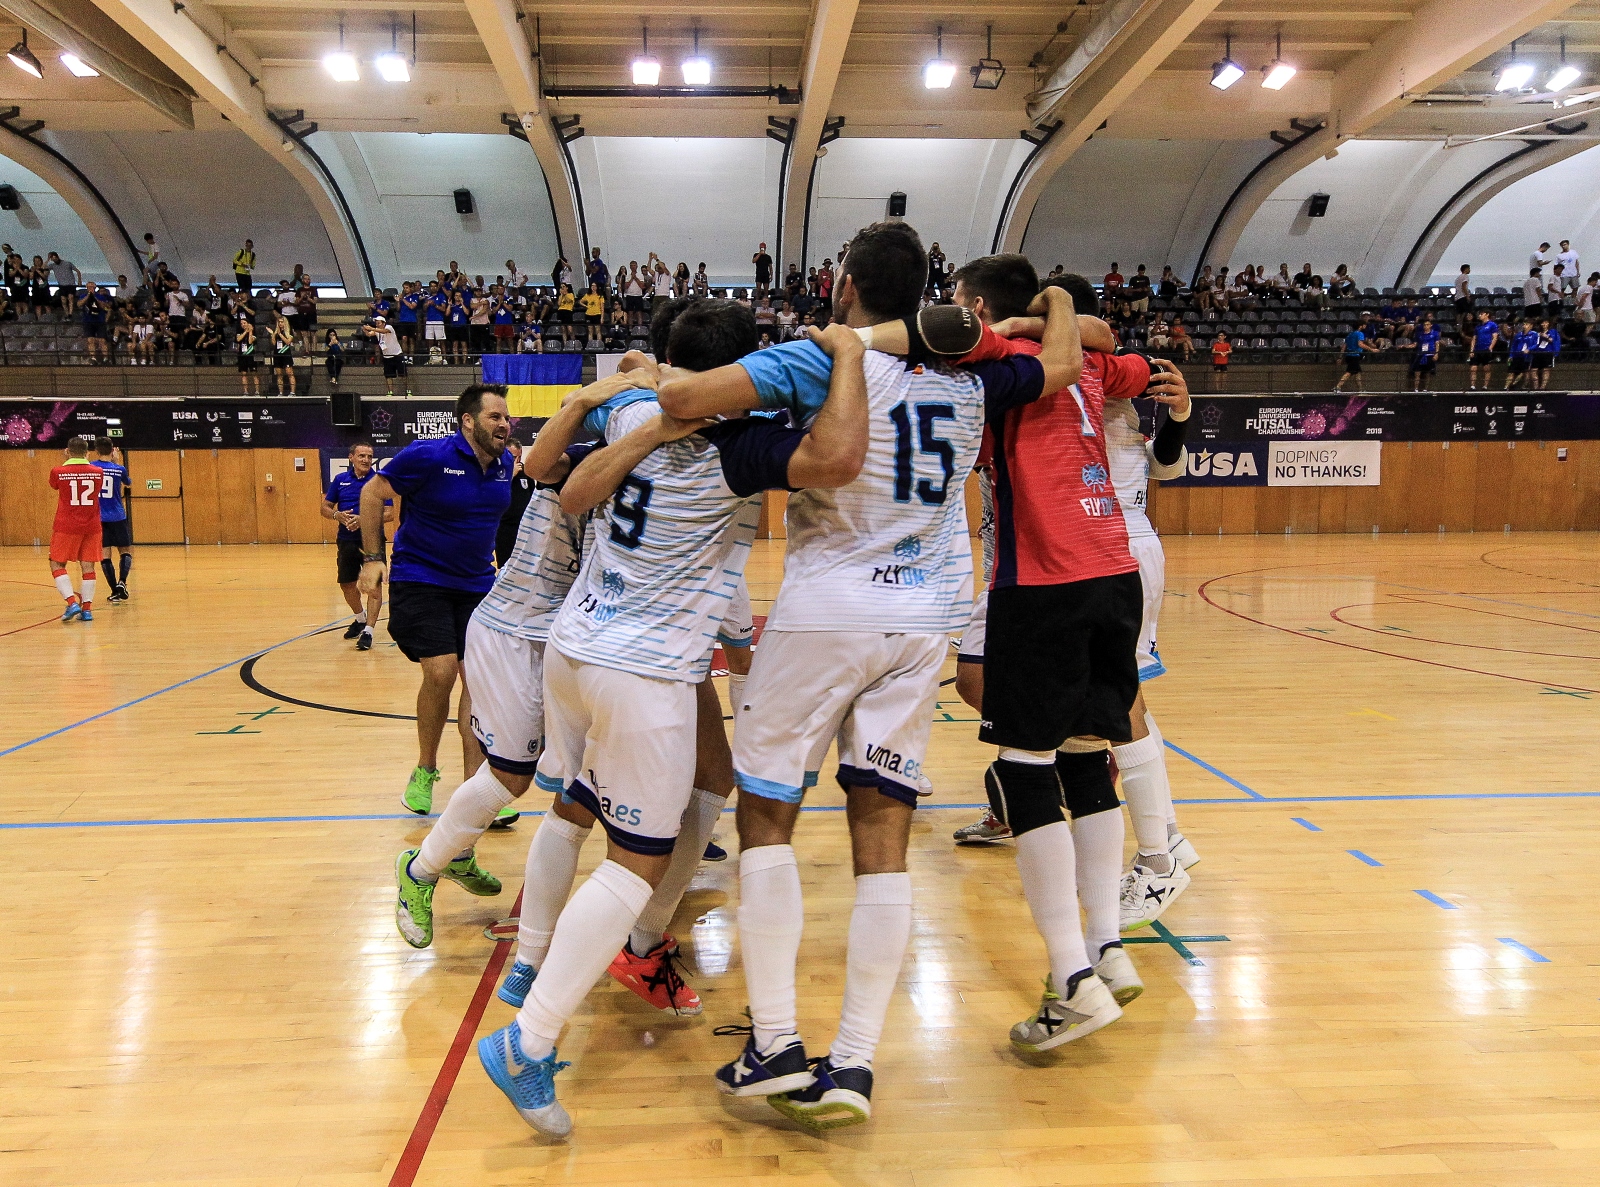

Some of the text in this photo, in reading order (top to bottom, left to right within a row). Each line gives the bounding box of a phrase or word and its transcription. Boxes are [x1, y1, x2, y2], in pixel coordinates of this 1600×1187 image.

[172, 411, 199, 420] EUSA
[1454, 406, 1478, 414] EUSA
[403, 422, 456, 434] FUTSAL
[1245, 419, 1293, 430] FUTSAL
[1366, 427, 1383, 435] 2019
[889, 400, 956, 507] 15
[1276, 450, 1338, 463] DOPING?
[1180, 448, 1259, 477] USA
[443, 467, 466, 477] Kempa
[1275, 466, 1367, 478] NO THANKS!
[69, 480, 95, 506] 12
[609, 473, 655, 552] 9
[588, 768, 642, 827] ua.es
